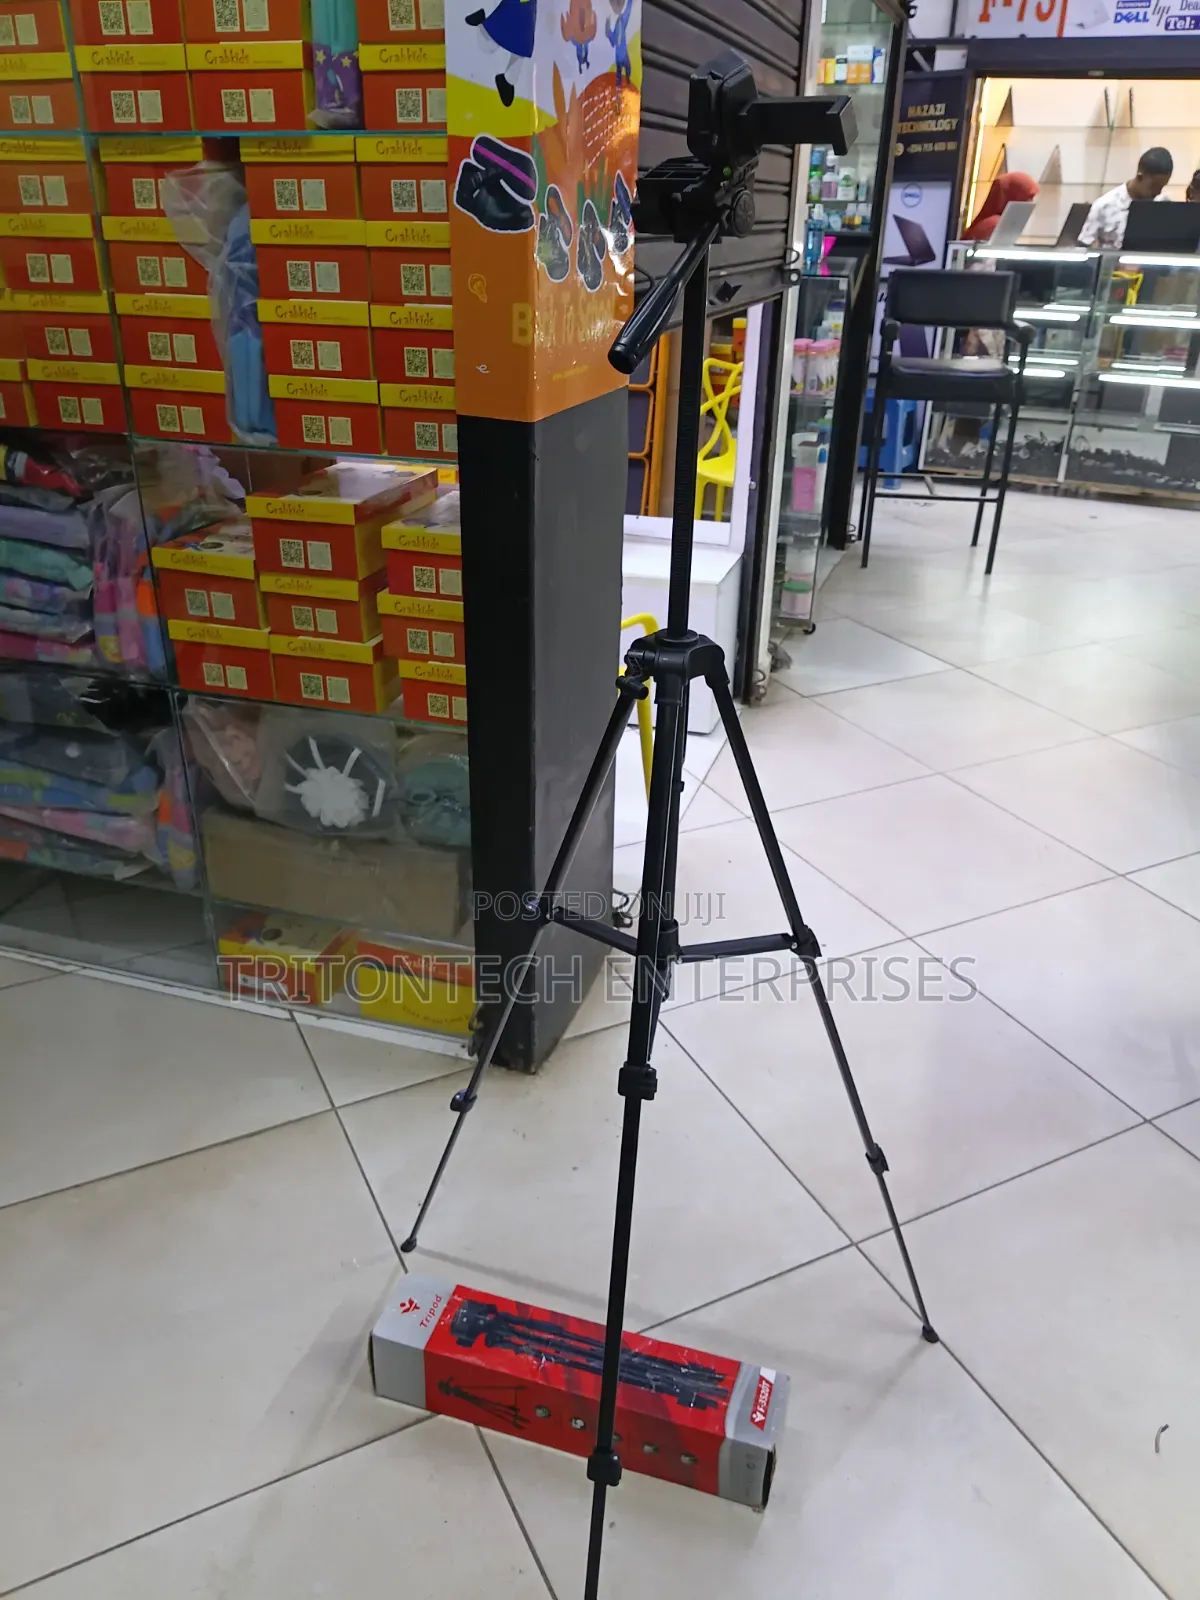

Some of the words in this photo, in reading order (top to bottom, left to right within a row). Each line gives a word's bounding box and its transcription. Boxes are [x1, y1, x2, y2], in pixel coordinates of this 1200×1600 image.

[1113, 11, 1149, 23] DELL
[1167, 16, 1195, 30] Tel:
[92, 50, 135, 67] Crabkids
[205, 49, 250, 66] Crabkids
[379, 49, 428, 66] Crabkids
[376, 140, 423, 157] Crabkids
[385, 226, 432, 244] Crabkids
[275, 303, 319, 320] Crabkids
[389, 310, 435, 326] Crabkids
[286, 382, 329, 398] Crabkids
[419, 1293, 443, 1329] Tripod
